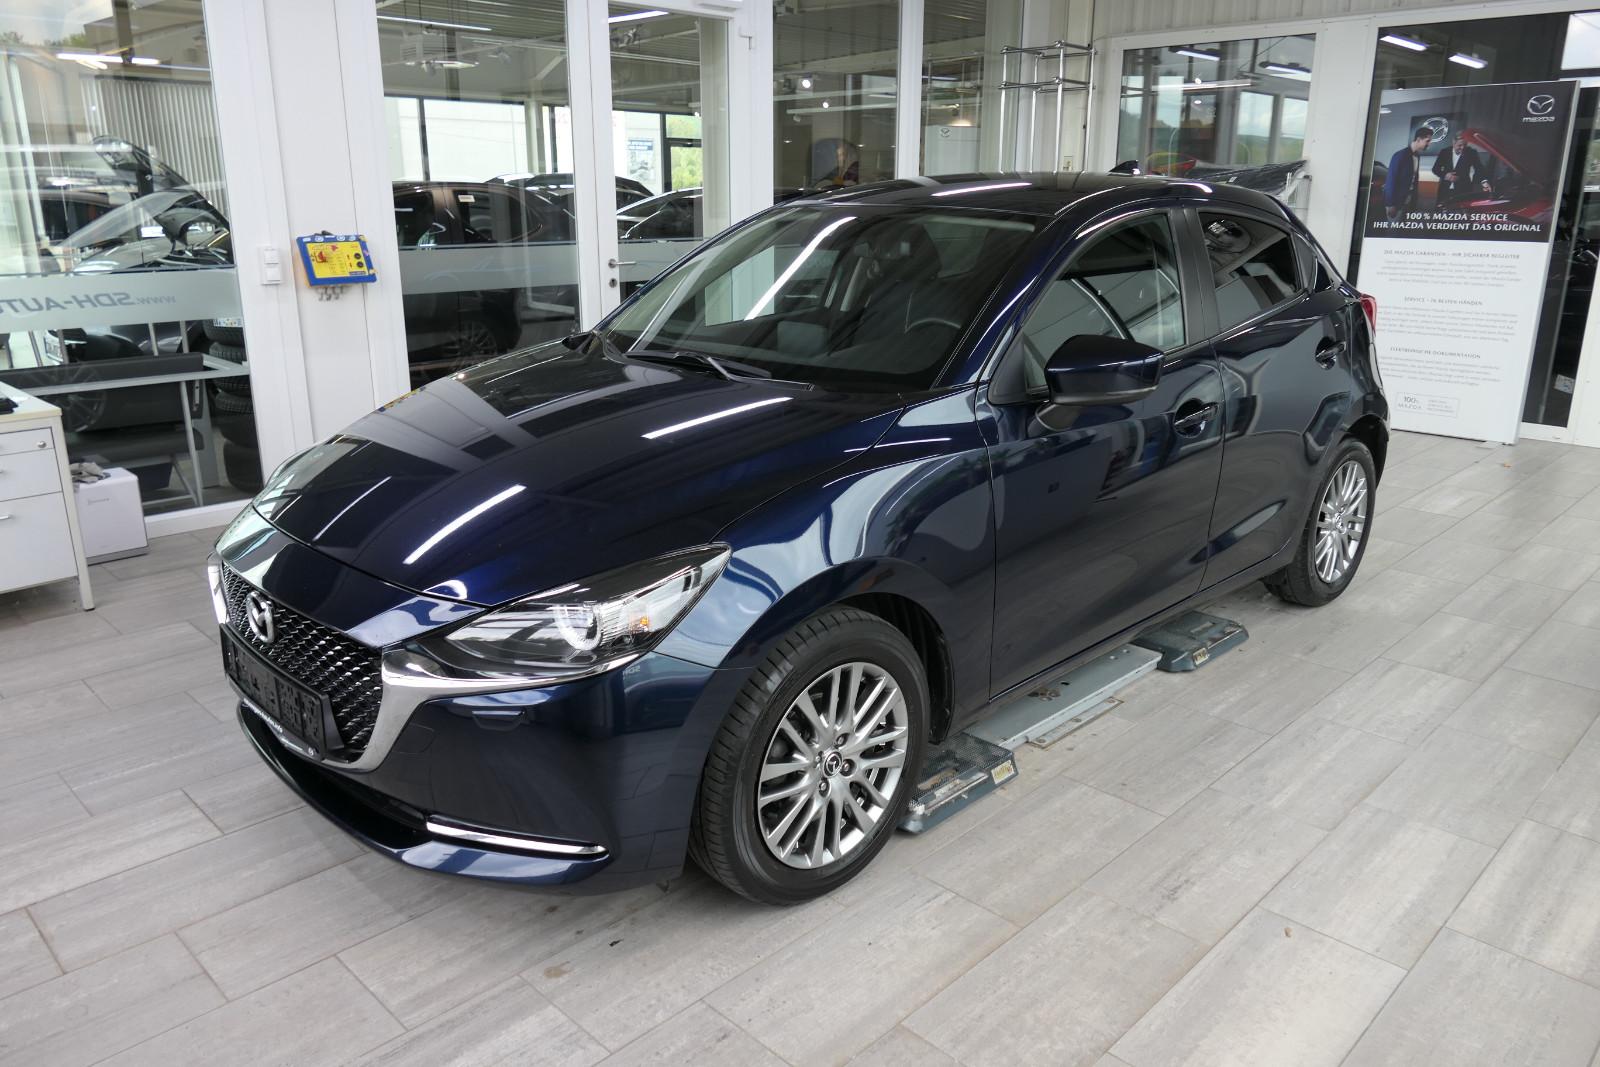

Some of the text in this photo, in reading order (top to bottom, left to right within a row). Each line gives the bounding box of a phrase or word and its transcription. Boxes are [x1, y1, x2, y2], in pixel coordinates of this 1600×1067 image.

[1405, 212, 1423, 220] 100
[1433, 212, 1468, 221] MAZDA
[1469, 213, 1508, 222] SERVICE
[1373, 221, 1541, 232] IHR MAZDA VERDIENT DAS ORIGINAL
